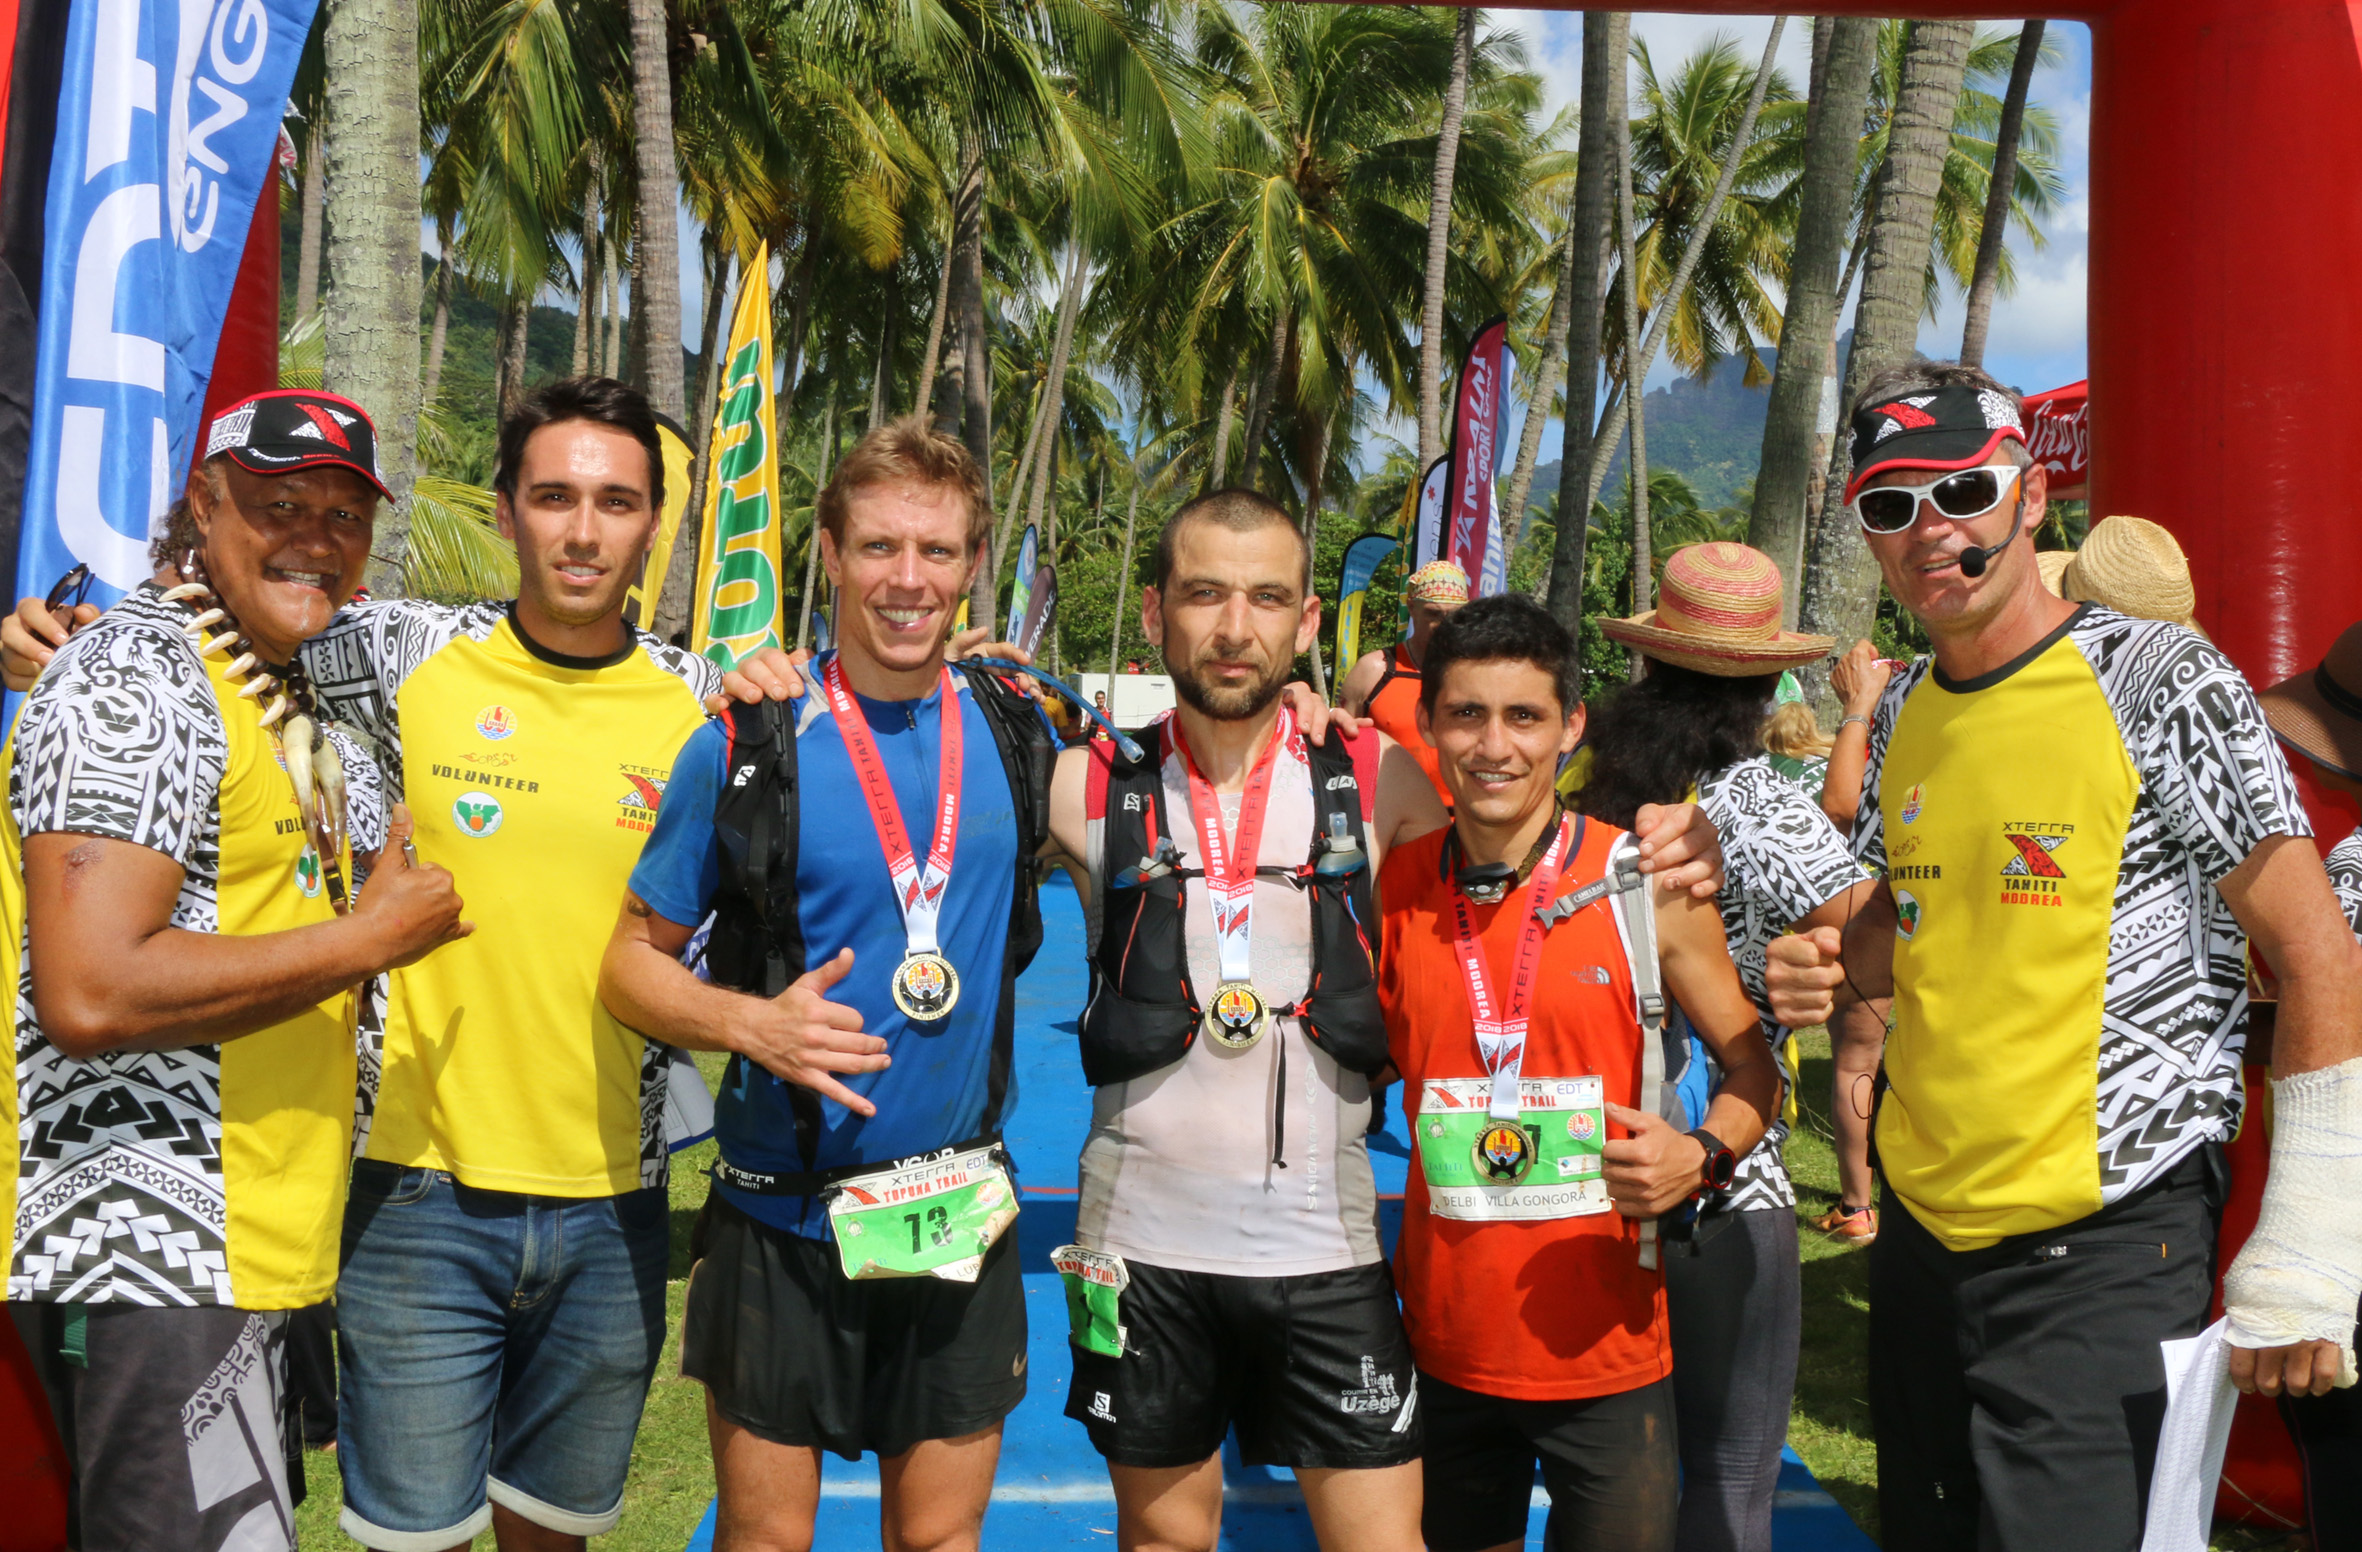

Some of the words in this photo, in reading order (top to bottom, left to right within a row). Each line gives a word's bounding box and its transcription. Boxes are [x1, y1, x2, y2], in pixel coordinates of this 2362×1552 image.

[432, 763, 540, 793] VOLUNTEER
[619, 763, 669, 777] XTERR
[622, 807, 657, 823] TAHI
[938, 793, 955, 853] MOOREA
[616, 817, 654, 834] MOOR
[2002, 821, 2075, 834] XTERRA
[1204, 817, 1226, 876] MOOREA
[890, 856, 915, 876] 2018
[928, 854, 951, 872] 2018
[1208, 879, 1228, 891] 201
[1228, 884, 1254, 899] 2018
[1573, 883, 1606, 903] CAMELBAK
[2004, 878, 2057, 892] TAHITI
[2000, 892, 2062, 907] MOOREA
[1455, 901, 1474, 951] TAHITI
[1466, 957, 1491, 1020] MOOREA
[1475, 1022, 1502, 1033] 2018
[1503, 1022, 1528, 1033] 2018
[1557, 1083, 1583, 1095] EDT
[1521, 1095, 1557, 1107] TRAIL
[728, 1165, 775, 1184] XTERRA
[892, 1163, 955, 1186] XTERRA
[966, 1154, 987, 1170] EDT
[737, 1178, 760, 1189] TAHITI
[936, 1172, 968, 1190] TRAIL
[1444, 1195, 1476, 1207] DELBI
[1485, 1196, 1522, 1207] VILLA
[1522, 1191, 1587, 1206] GONGORA
[903, 1206, 953, 1255] 73
[1341, 1394, 1400, 1414] Uzège
